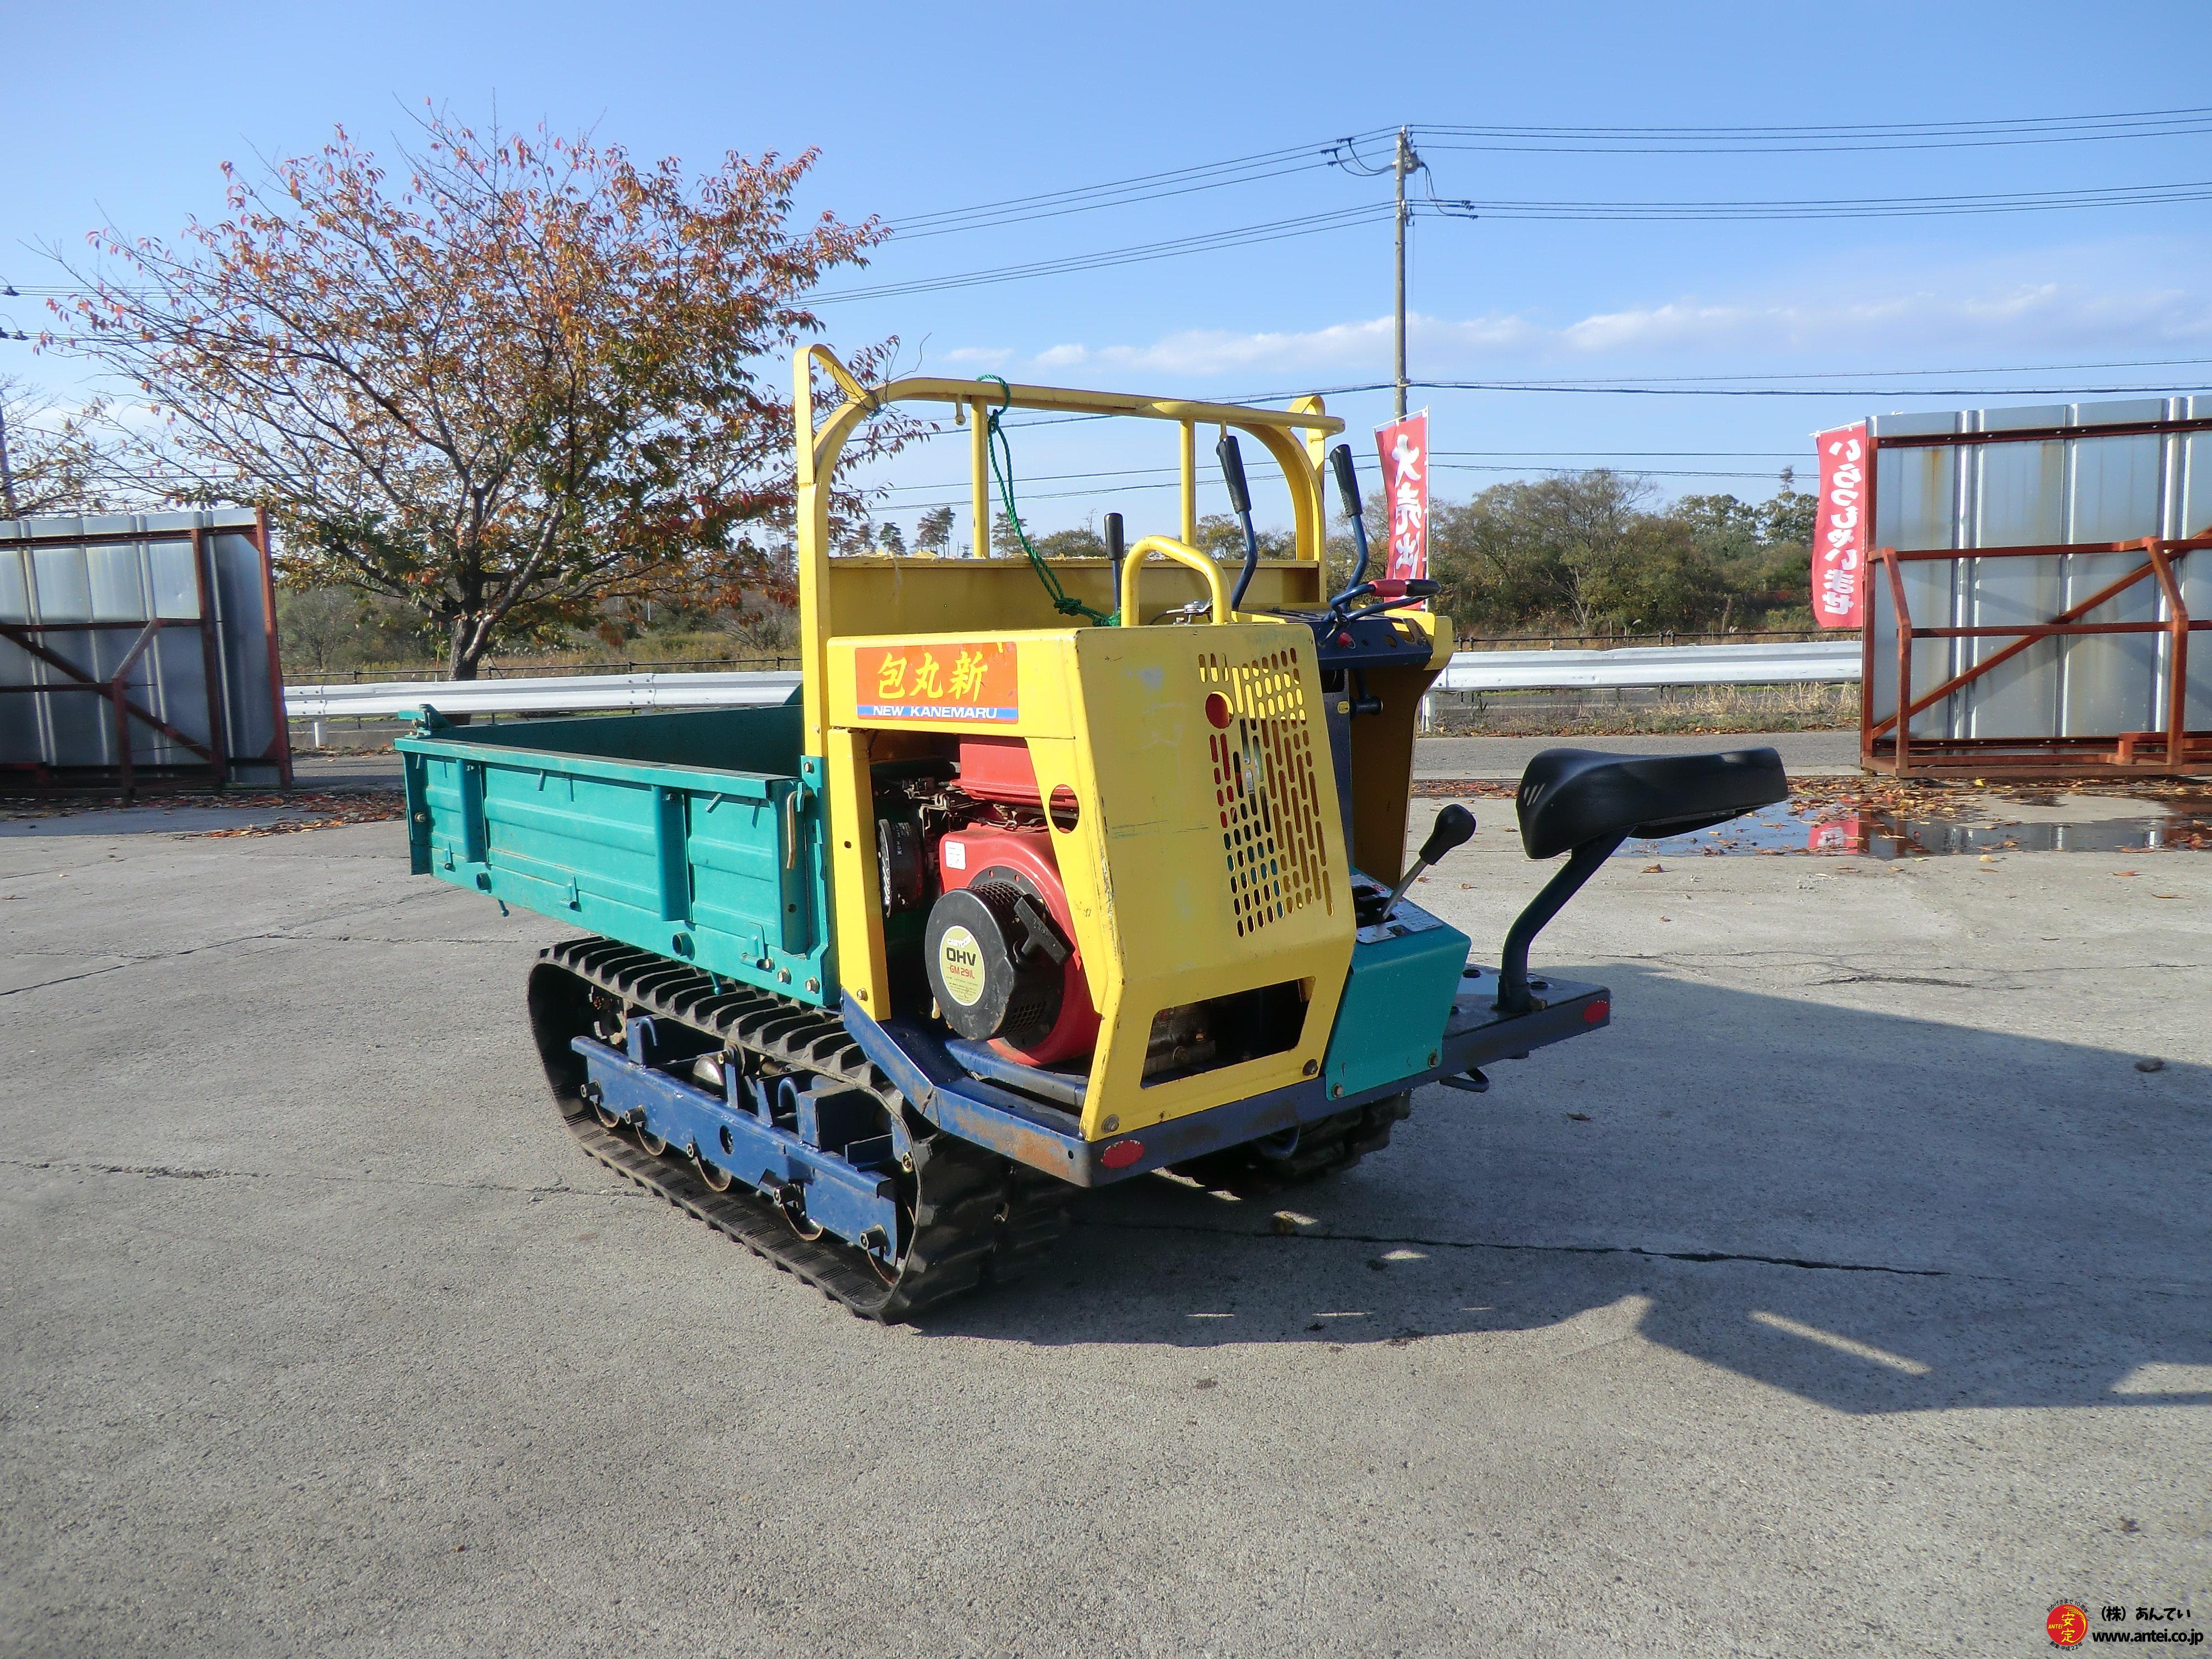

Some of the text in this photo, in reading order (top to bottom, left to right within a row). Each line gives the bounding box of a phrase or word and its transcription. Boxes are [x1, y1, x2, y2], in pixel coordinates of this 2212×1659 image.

[873, 706, 998, 719] NEW KANEMARU
[946, 947, 976, 966] OHV
